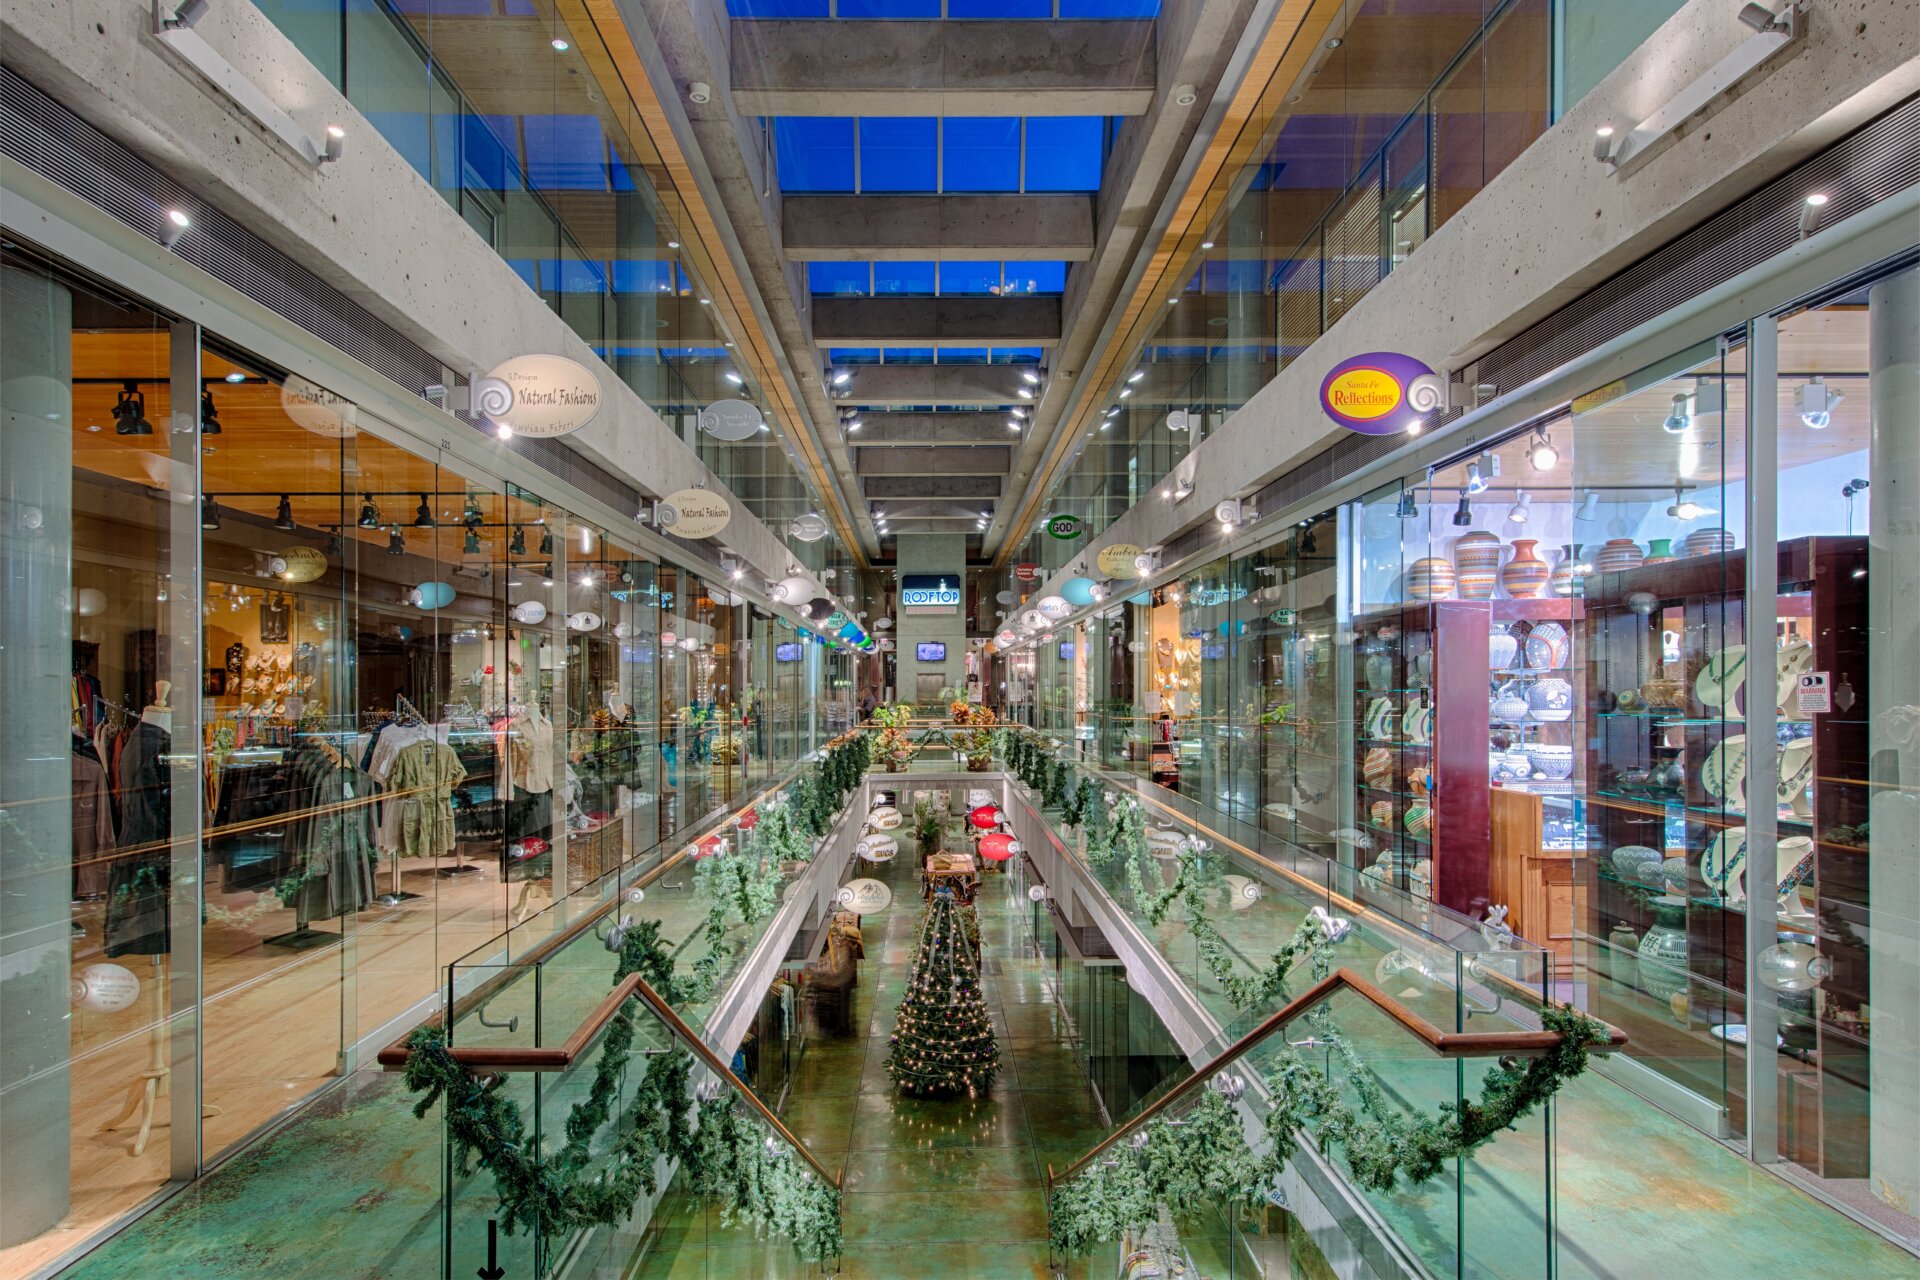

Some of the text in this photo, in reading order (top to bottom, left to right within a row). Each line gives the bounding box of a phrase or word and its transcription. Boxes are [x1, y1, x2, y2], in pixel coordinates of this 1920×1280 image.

[1346, 381, 1379, 389] Santa Fe
[519, 386, 597, 406] Natural Fashions
[1334, 390, 1394, 406] Reflections
[681, 505, 729, 519] Natural Fashions
[1052, 522, 1073, 533] GOD
[1101, 546, 1138, 556] Amber
[904, 591, 958, 603] ROOFTOP
[1800, 687, 1826, 695] WARNING
